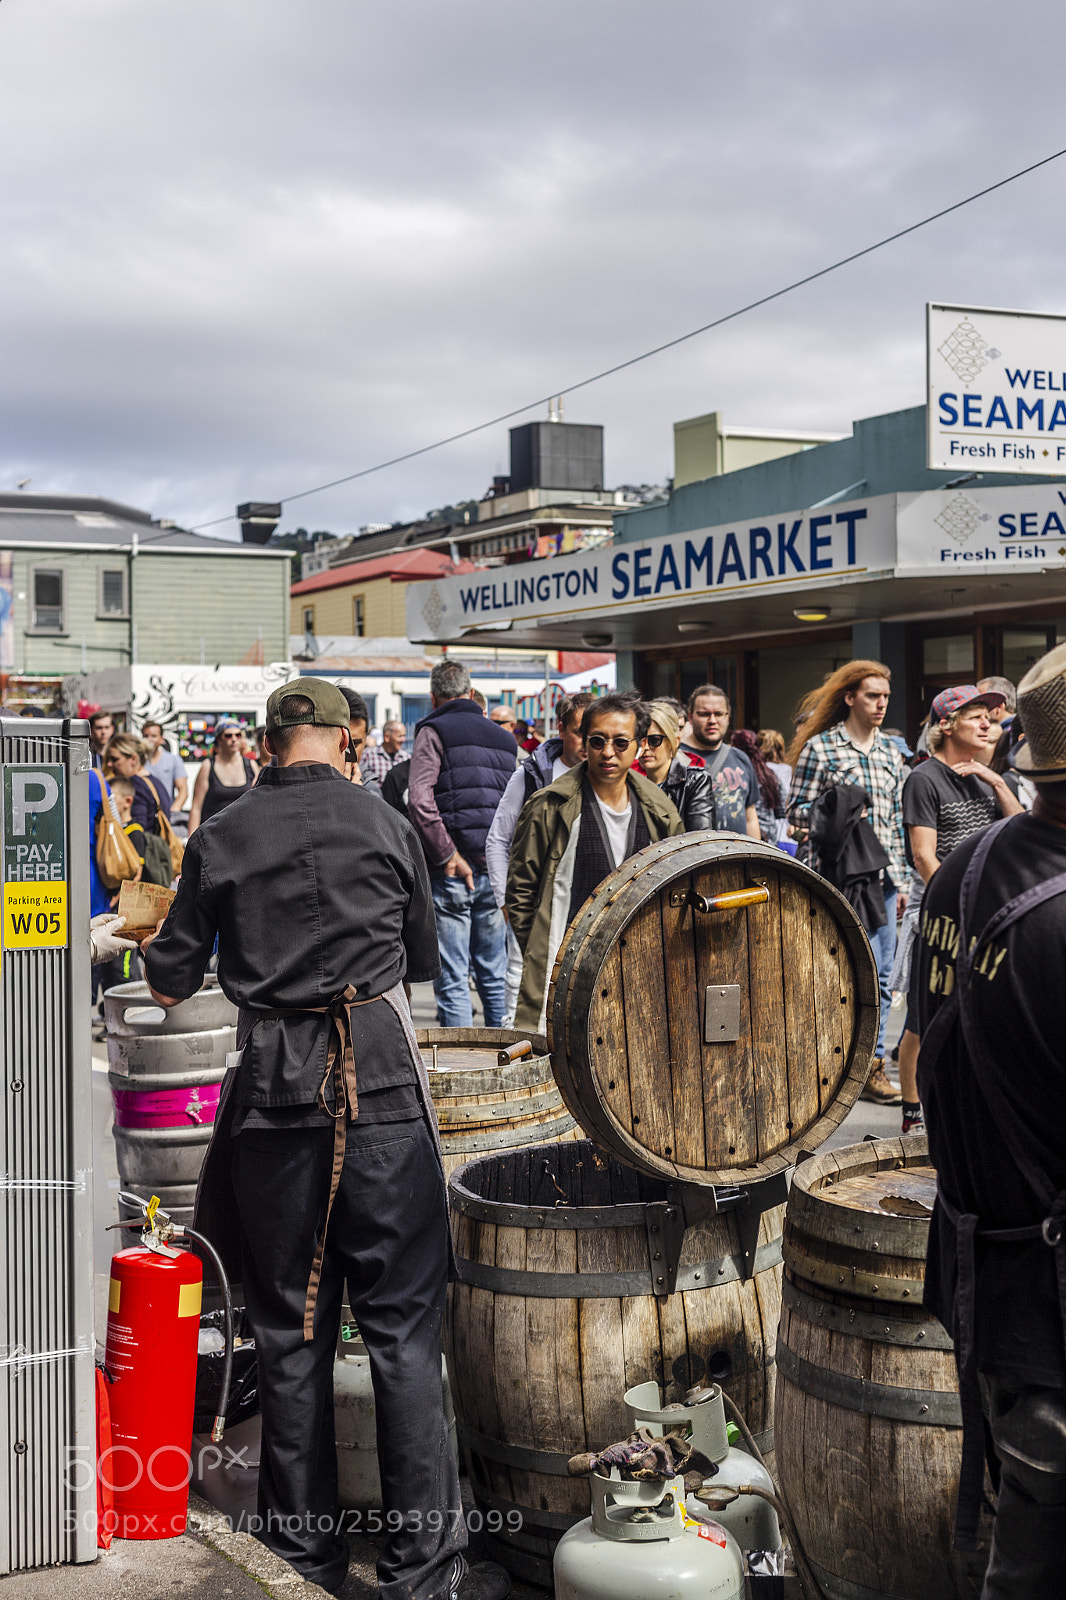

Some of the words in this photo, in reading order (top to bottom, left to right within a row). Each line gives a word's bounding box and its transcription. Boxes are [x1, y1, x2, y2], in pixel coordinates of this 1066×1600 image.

[938, 392, 1066, 432] SEAMA
[950, 440, 996, 458] Fresh
[1003, 443, 1035, 460] Fish
[998, 511, 1066, 538] SEA
[460, 566, 598, 614] WELLINGTON
[612, 508, 867, 600] SEAMARKET
[940, 548, 996, 562] Fresh
[1005, 545, 1046, 559] Fish
[11, 772, 59, 836] P
[16, 843, 53, 863] PAY
[7, 862, 63, 882] HERE
[8, 895, 40, 907] Parking
[43, 894, 62, 905] Area
